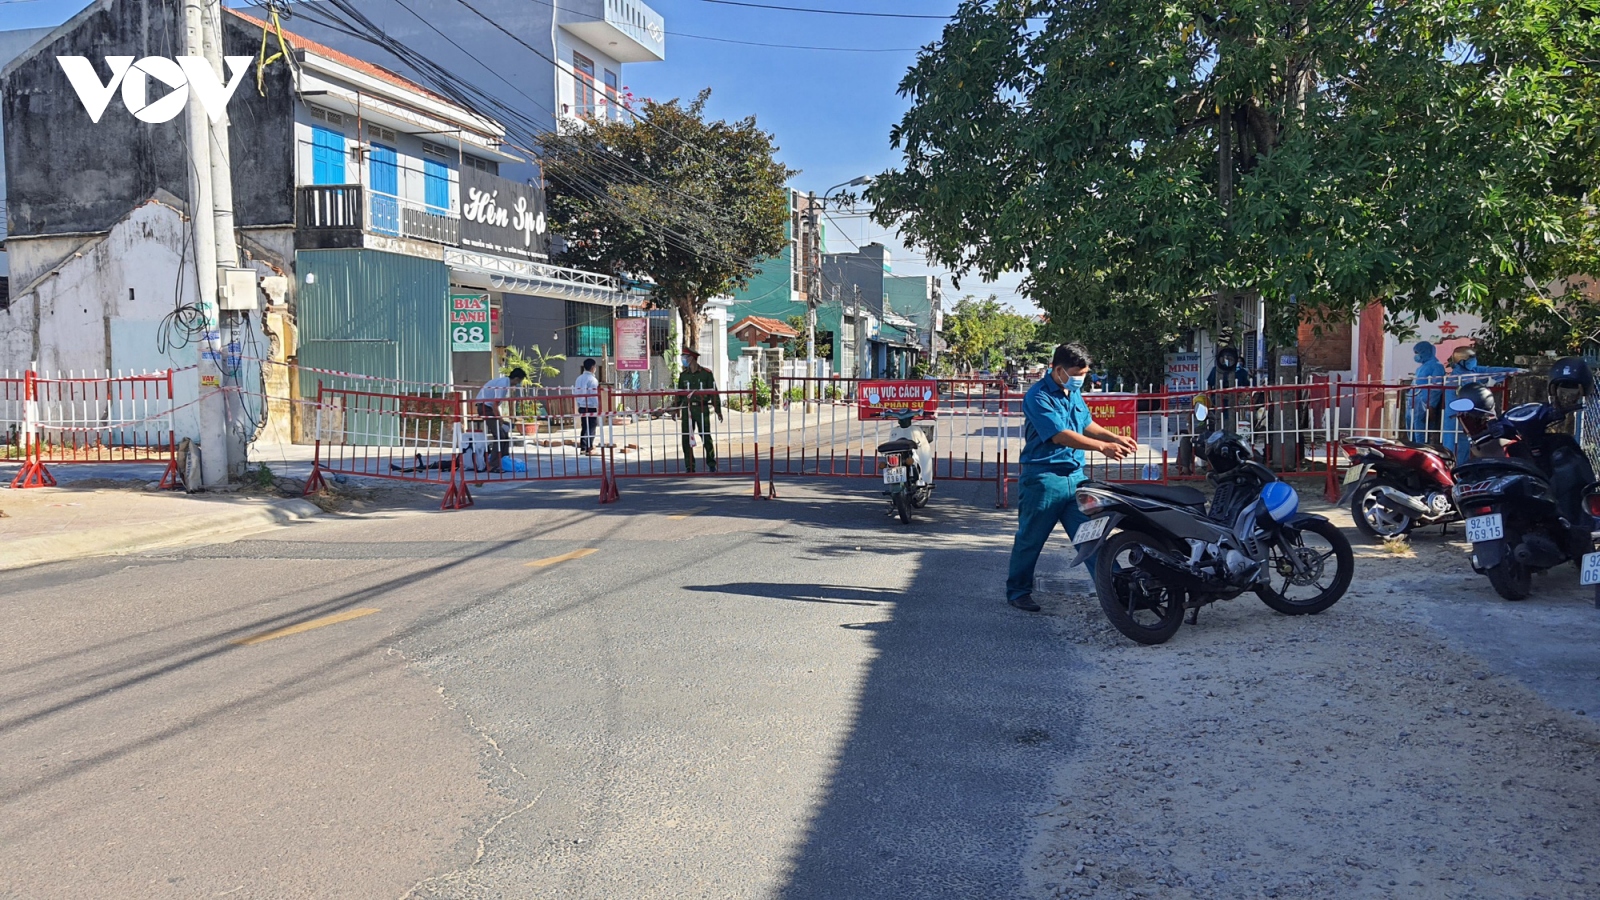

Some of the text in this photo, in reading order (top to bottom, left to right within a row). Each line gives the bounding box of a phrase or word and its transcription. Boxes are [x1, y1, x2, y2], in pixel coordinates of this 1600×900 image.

[513, 196, 546, 247] Spa
[454, 298, 482, 309] BIA
[451, 311, 487, 325] LẠNH
[453, 326, 484, 343] 68
[1168, 364, 1199, 372] MINH
[1171, 375, 1196, 386] TÂM
[898, 384, 920, 398] CÁCH
[1468, 526, 1501, 541] 269.15
